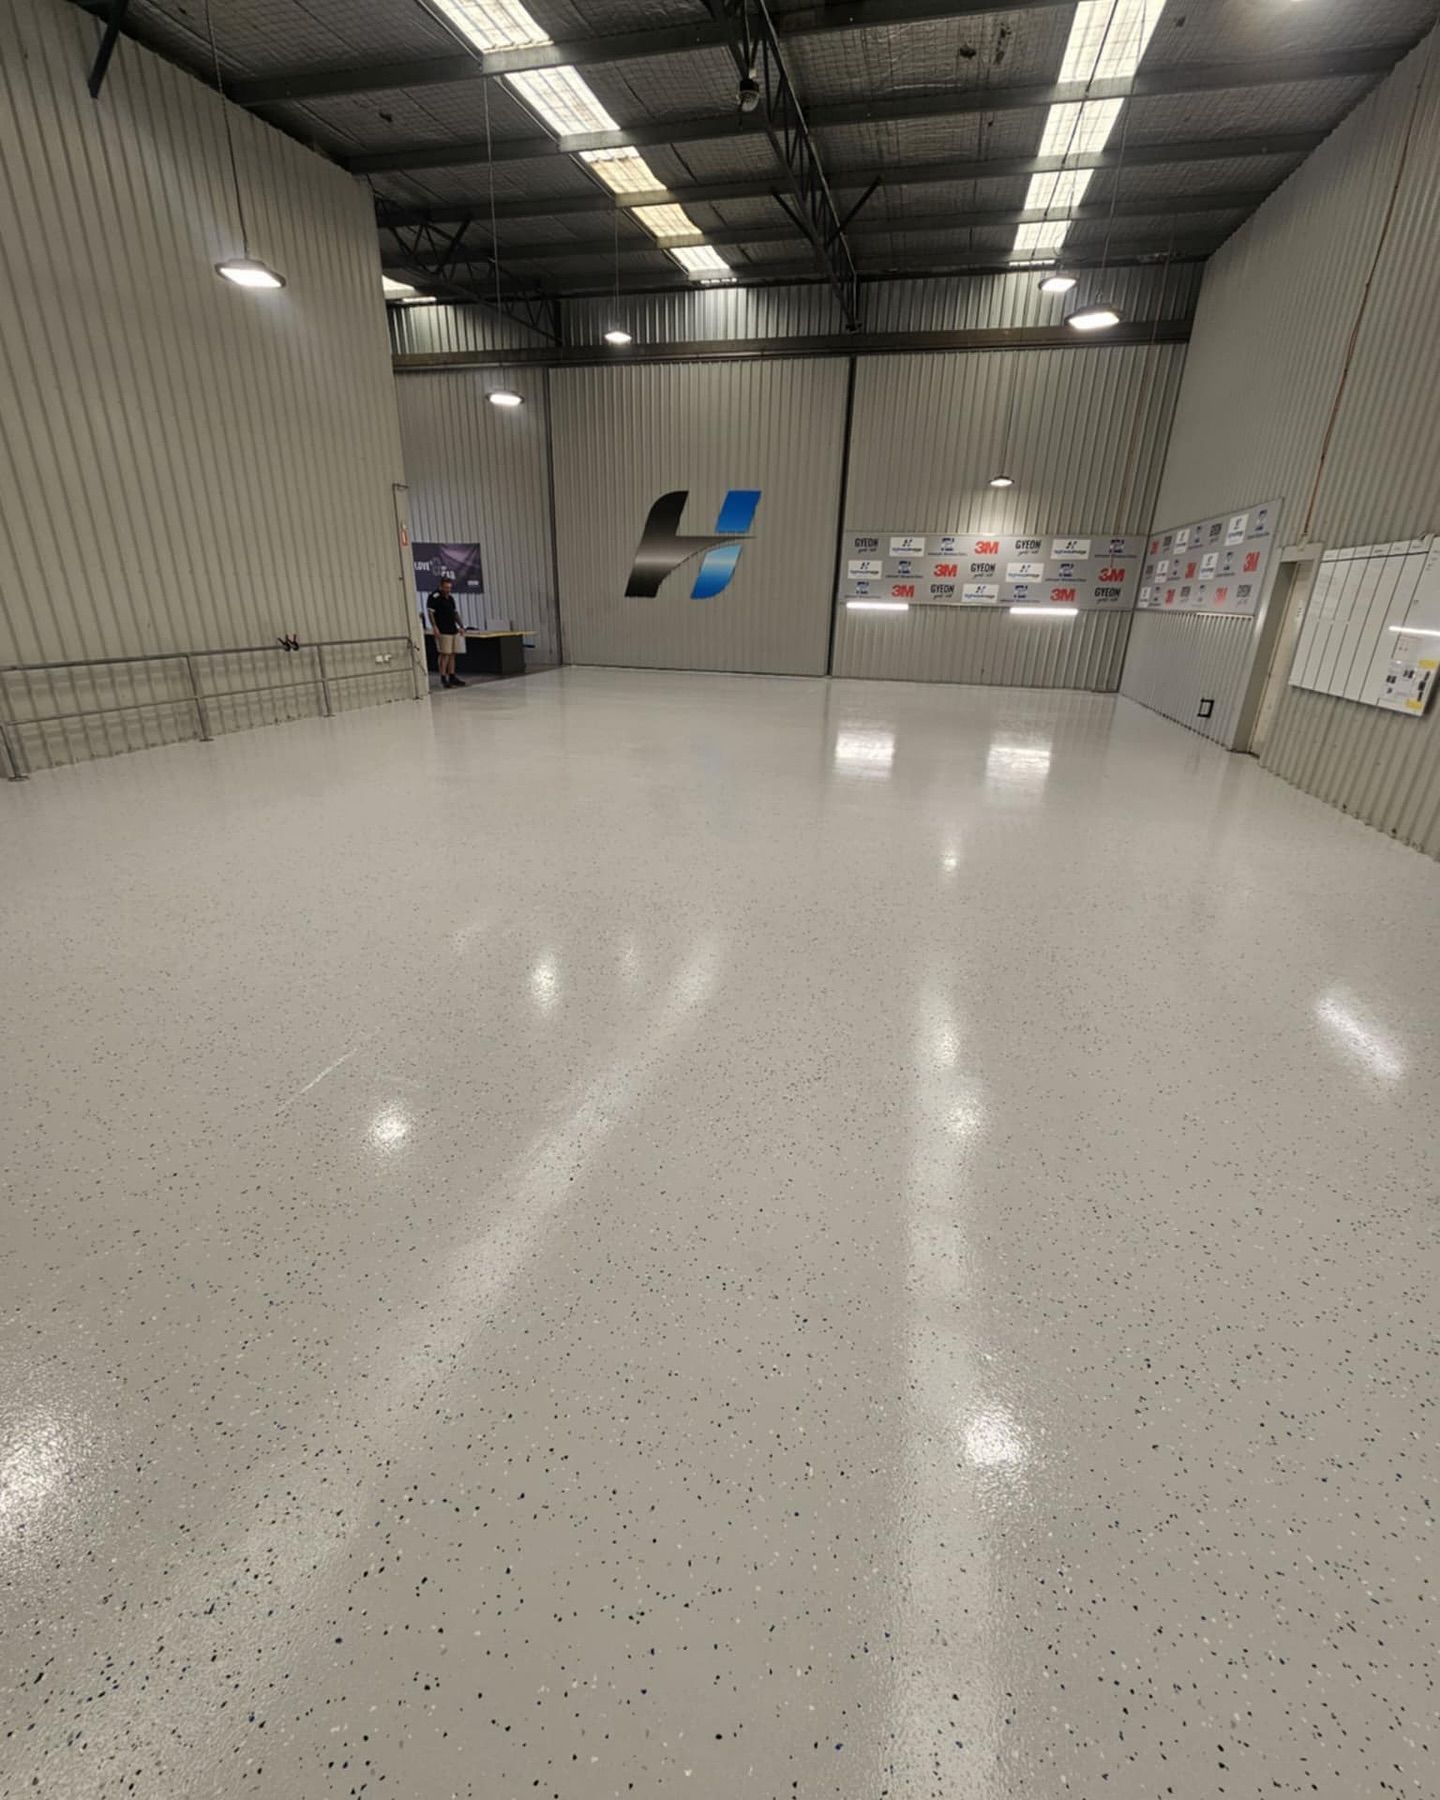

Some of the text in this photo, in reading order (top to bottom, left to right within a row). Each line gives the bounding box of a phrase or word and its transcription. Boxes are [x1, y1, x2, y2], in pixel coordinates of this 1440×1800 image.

[975, 541, 999, 554] 3M
[1015, 540, 1041, 549] GYEON
[934, 564, 957, 577] 3M
[971, 563, 996, 572] GYEON
[1099, 568, 1125, 582] 3M
[892, 585, 915, 597] 3M
[931, 584, 955, 593] GYEON
[1050, 588, 1076, 601] 3M
[1095, 587, 1121, 597] GYEON
